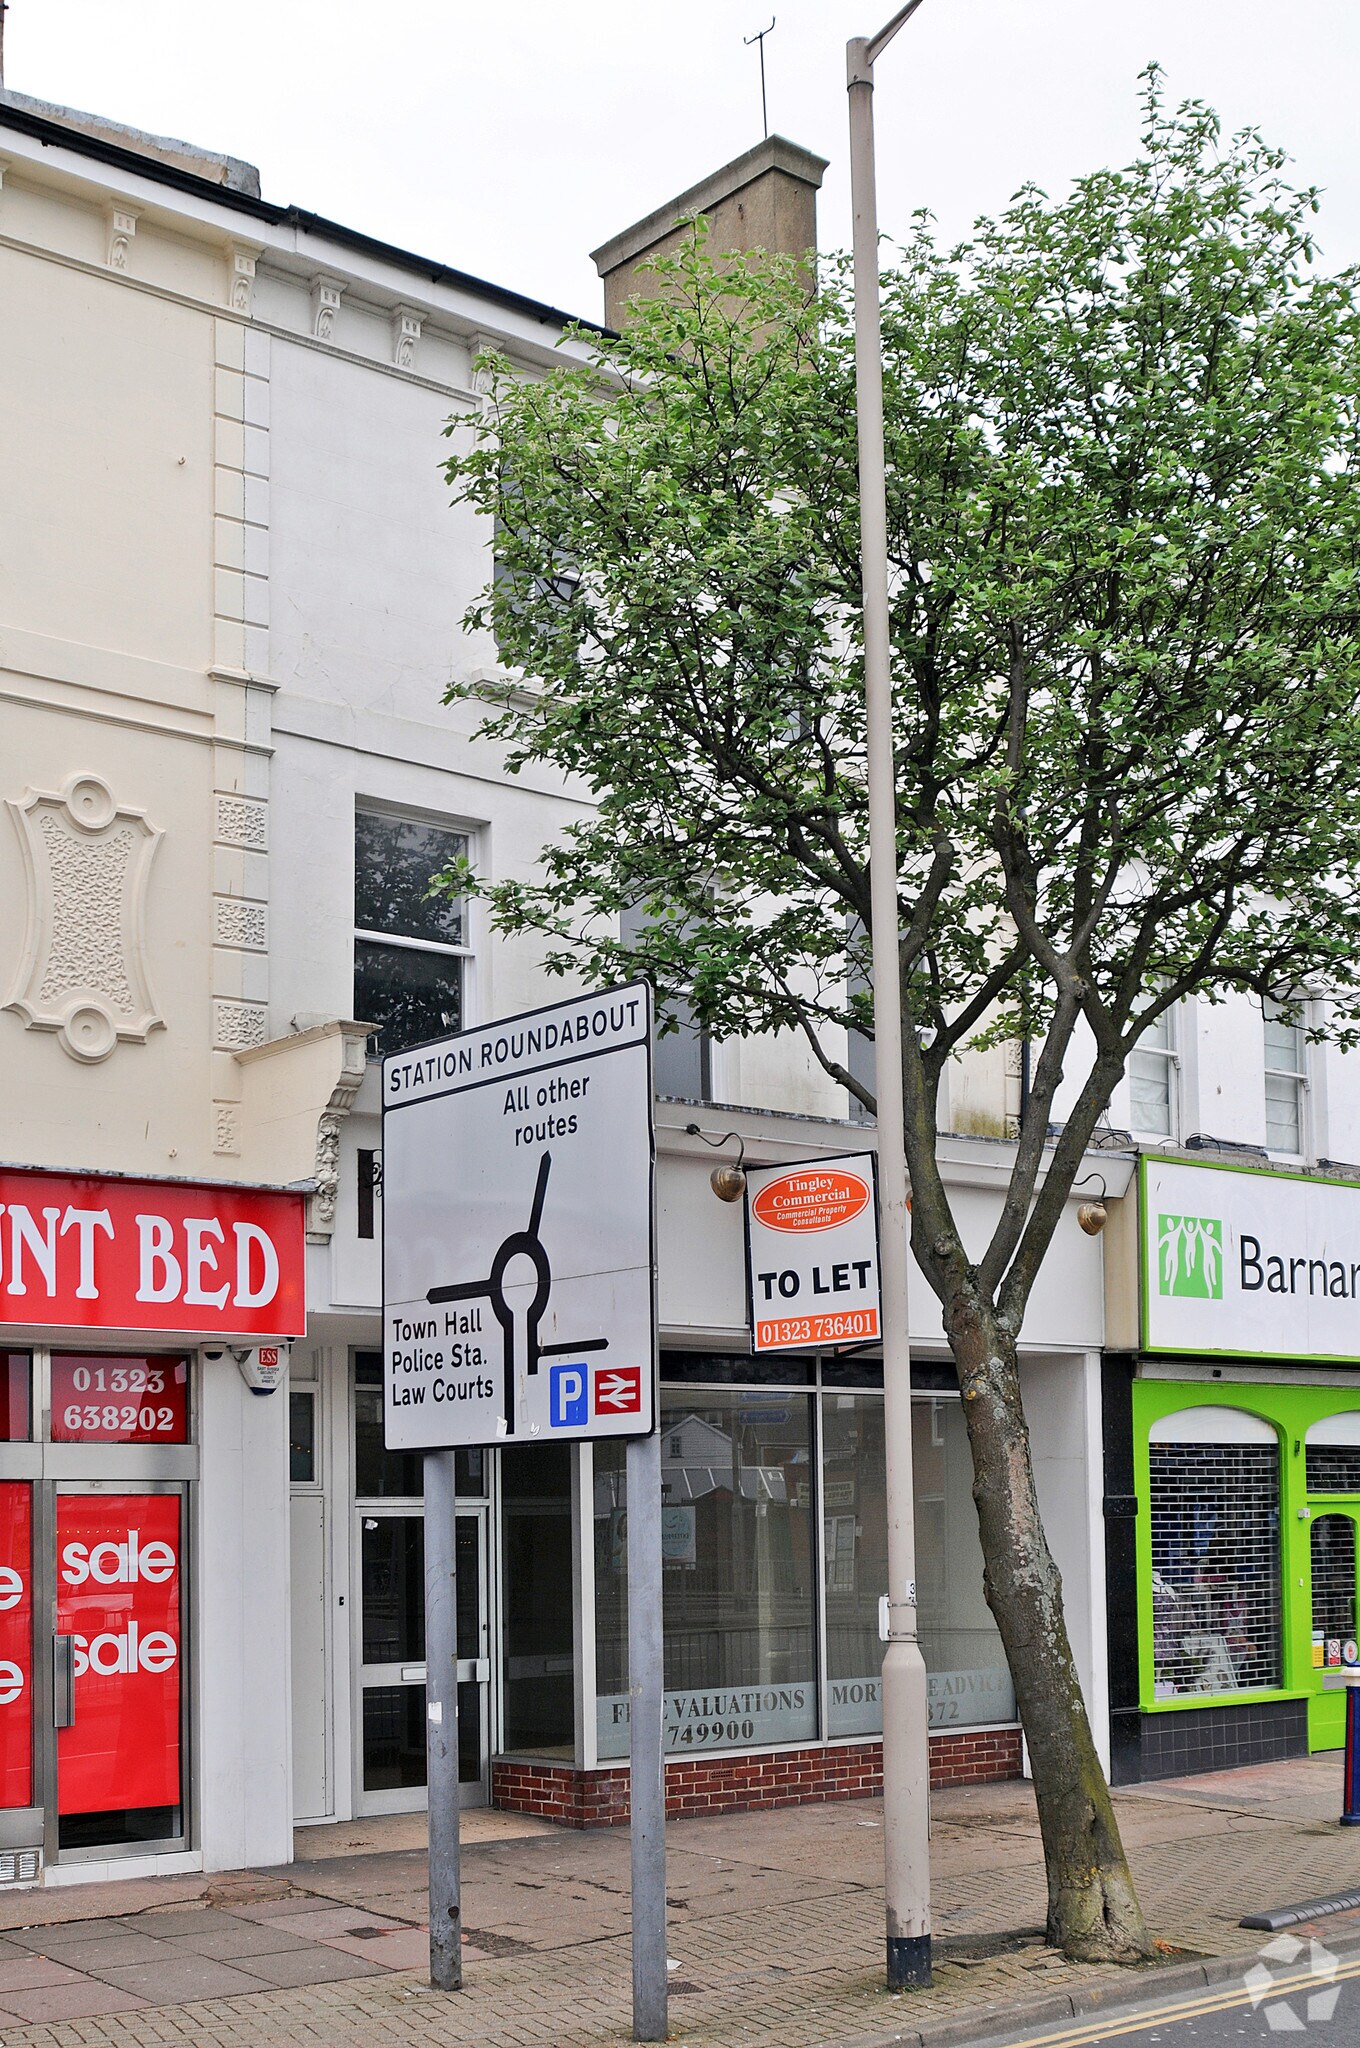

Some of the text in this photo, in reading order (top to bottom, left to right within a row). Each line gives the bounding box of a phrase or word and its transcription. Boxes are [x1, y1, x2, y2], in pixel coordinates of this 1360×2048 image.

[390, 1000, 639, 1092] STATION ROUNDABOUT
[503, 1076, 590, 1115] All other
[515, 1113, 578, 1146] routes
[772, 1187, 850, 1208] Commercial
[786, 1176, 834, 1192] Tingley
[776, 1204, 847, 1220] Commercial Property
[792, 1215, 832, 1226] Consultants
[0, 1204, 279, 1310] NT BED
[757, 1260, 872, 1301] TO LET
[392, 1308, 482, 1342] Town Hall
[762, 1313, 873, 1344] 01323 736401
[261, 1350, 277, 1363] ESS
[392, 1343, 487, 1374] Police Sta.
[72, 1367, 165, 1394] 01323
[392, 1378, 494, 1406] Law Courts
[559, 1371, 582, 1421] P
[63, 1405, 174, 1431] 638202
[61, 1530, 176, 1585] sale
[673, 1689, 805, 1718] VALUATIONS
[667, 1719, 754, 1745] 749900
